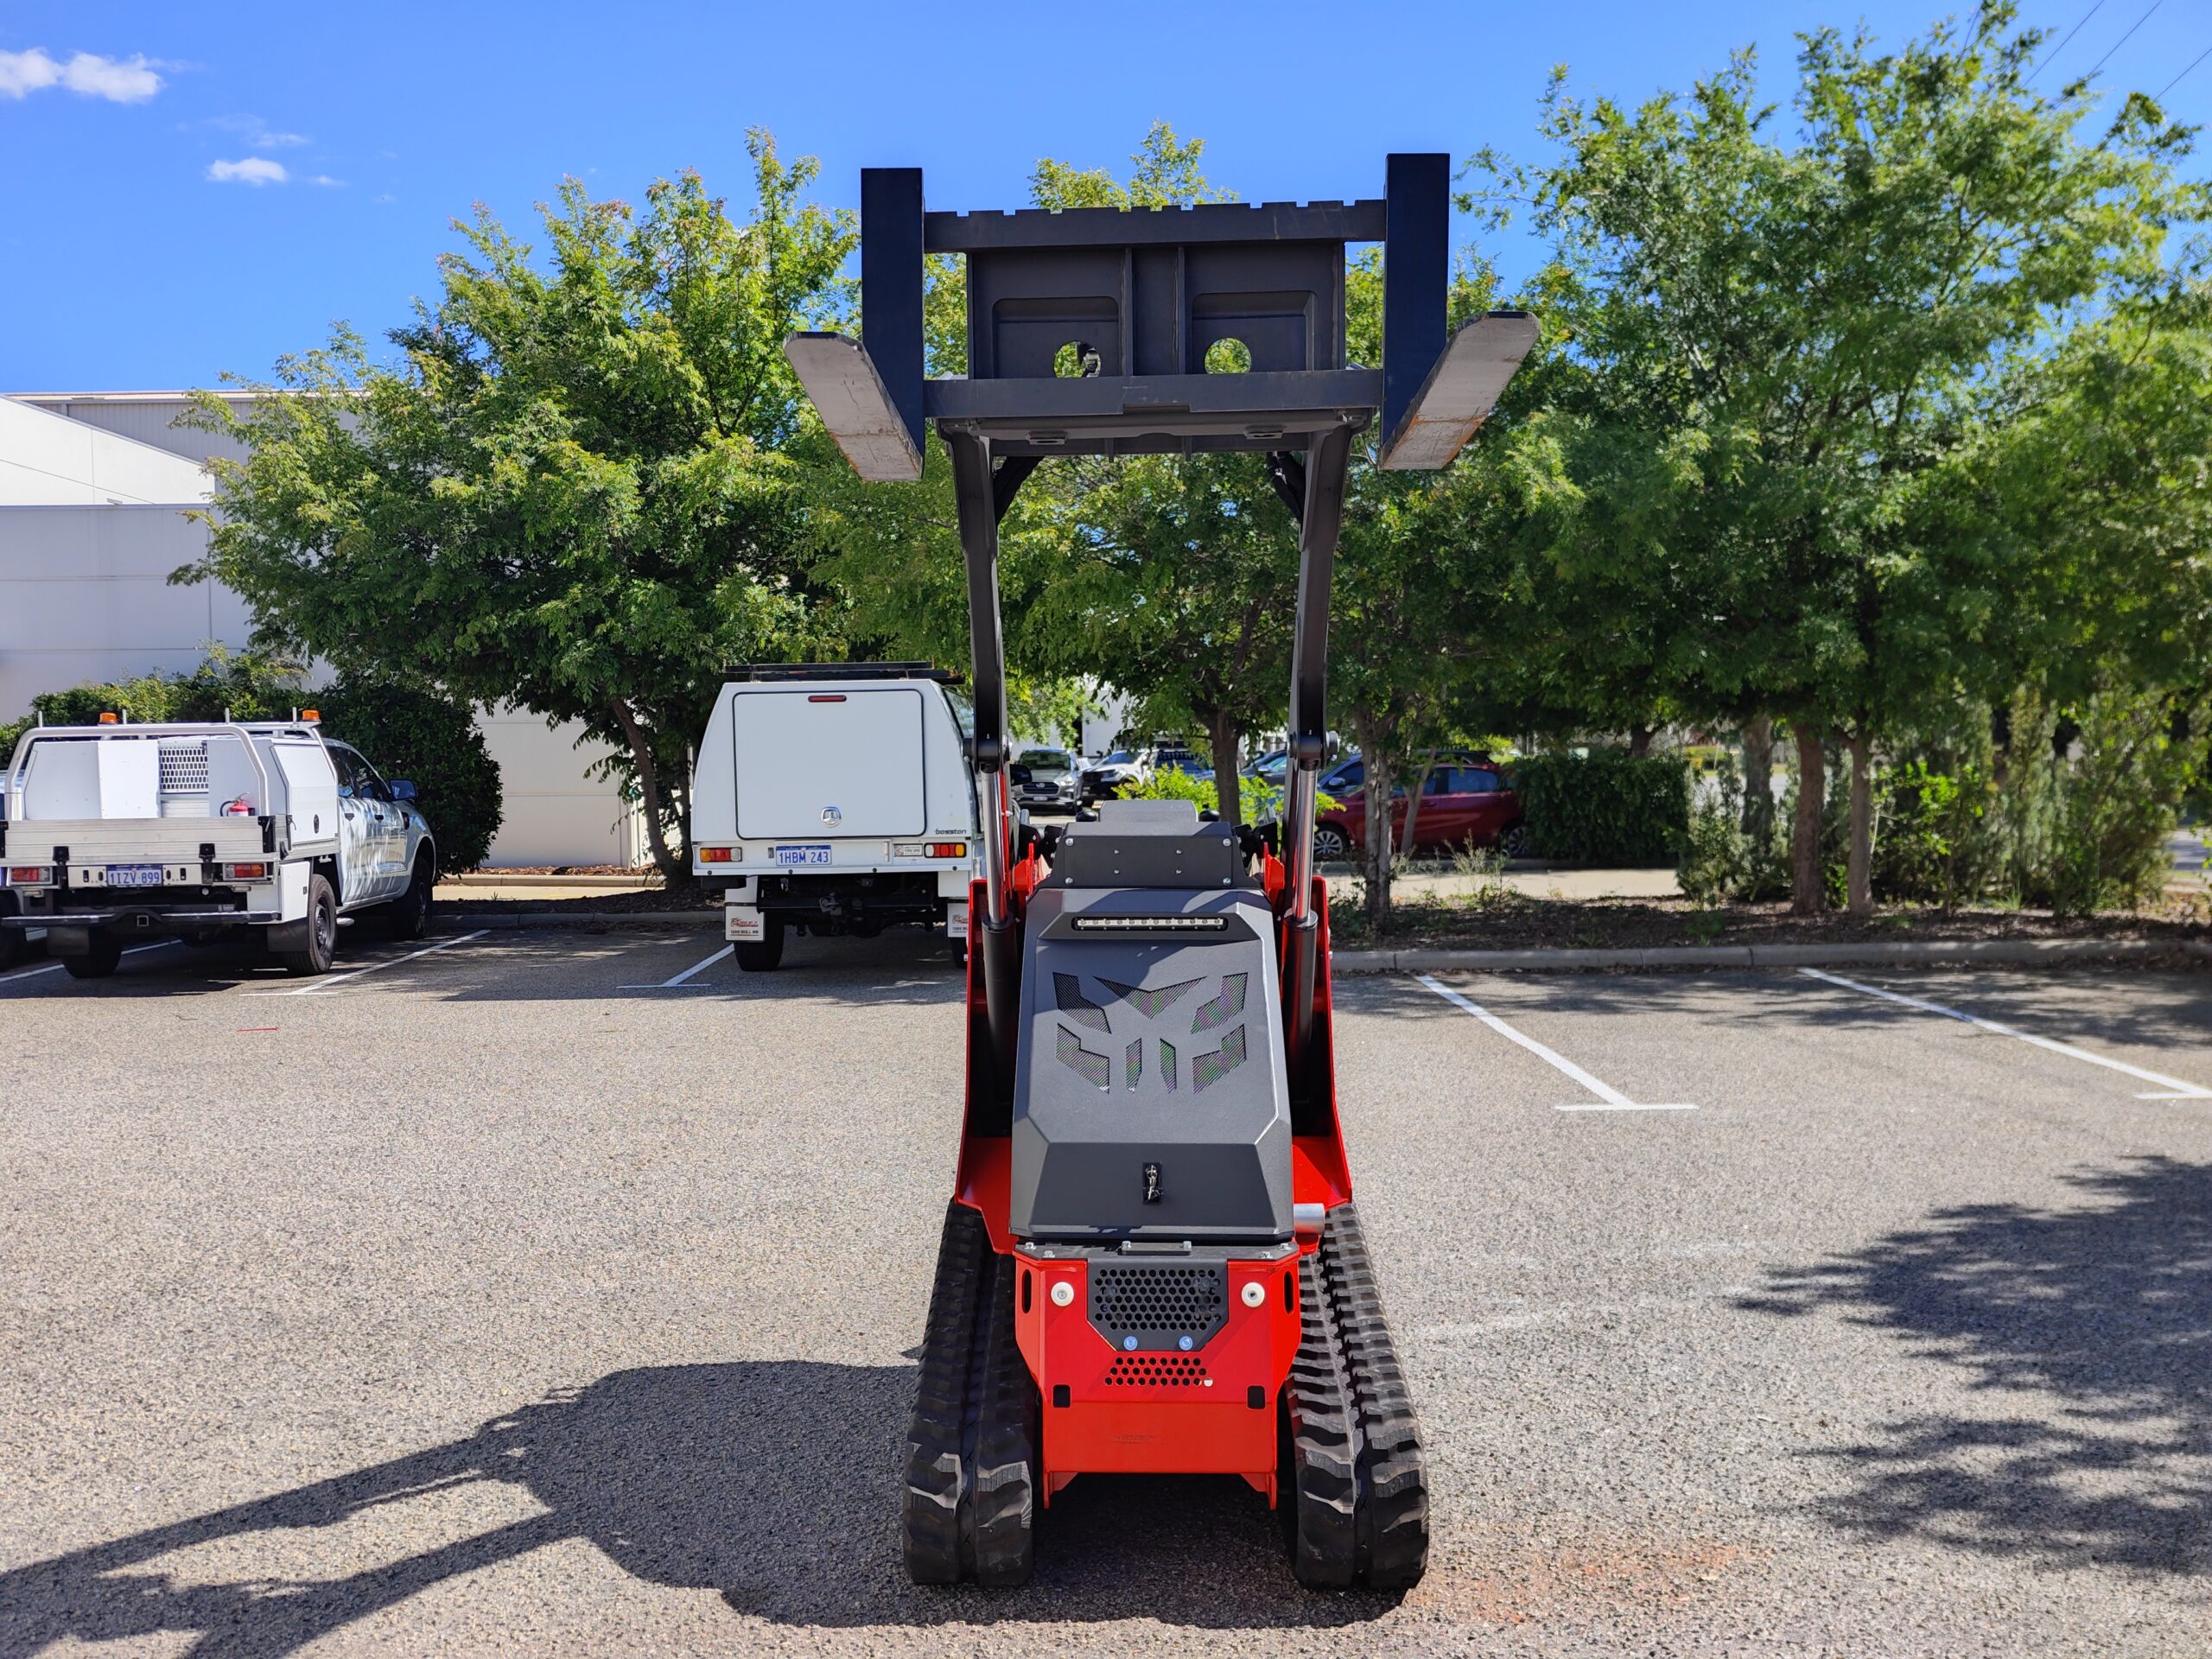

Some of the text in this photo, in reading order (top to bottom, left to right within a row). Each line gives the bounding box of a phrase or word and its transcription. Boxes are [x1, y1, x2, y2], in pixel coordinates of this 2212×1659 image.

[779, 851, 829, 864] 1HBM 243
[141, 872, 160, 884] 899
